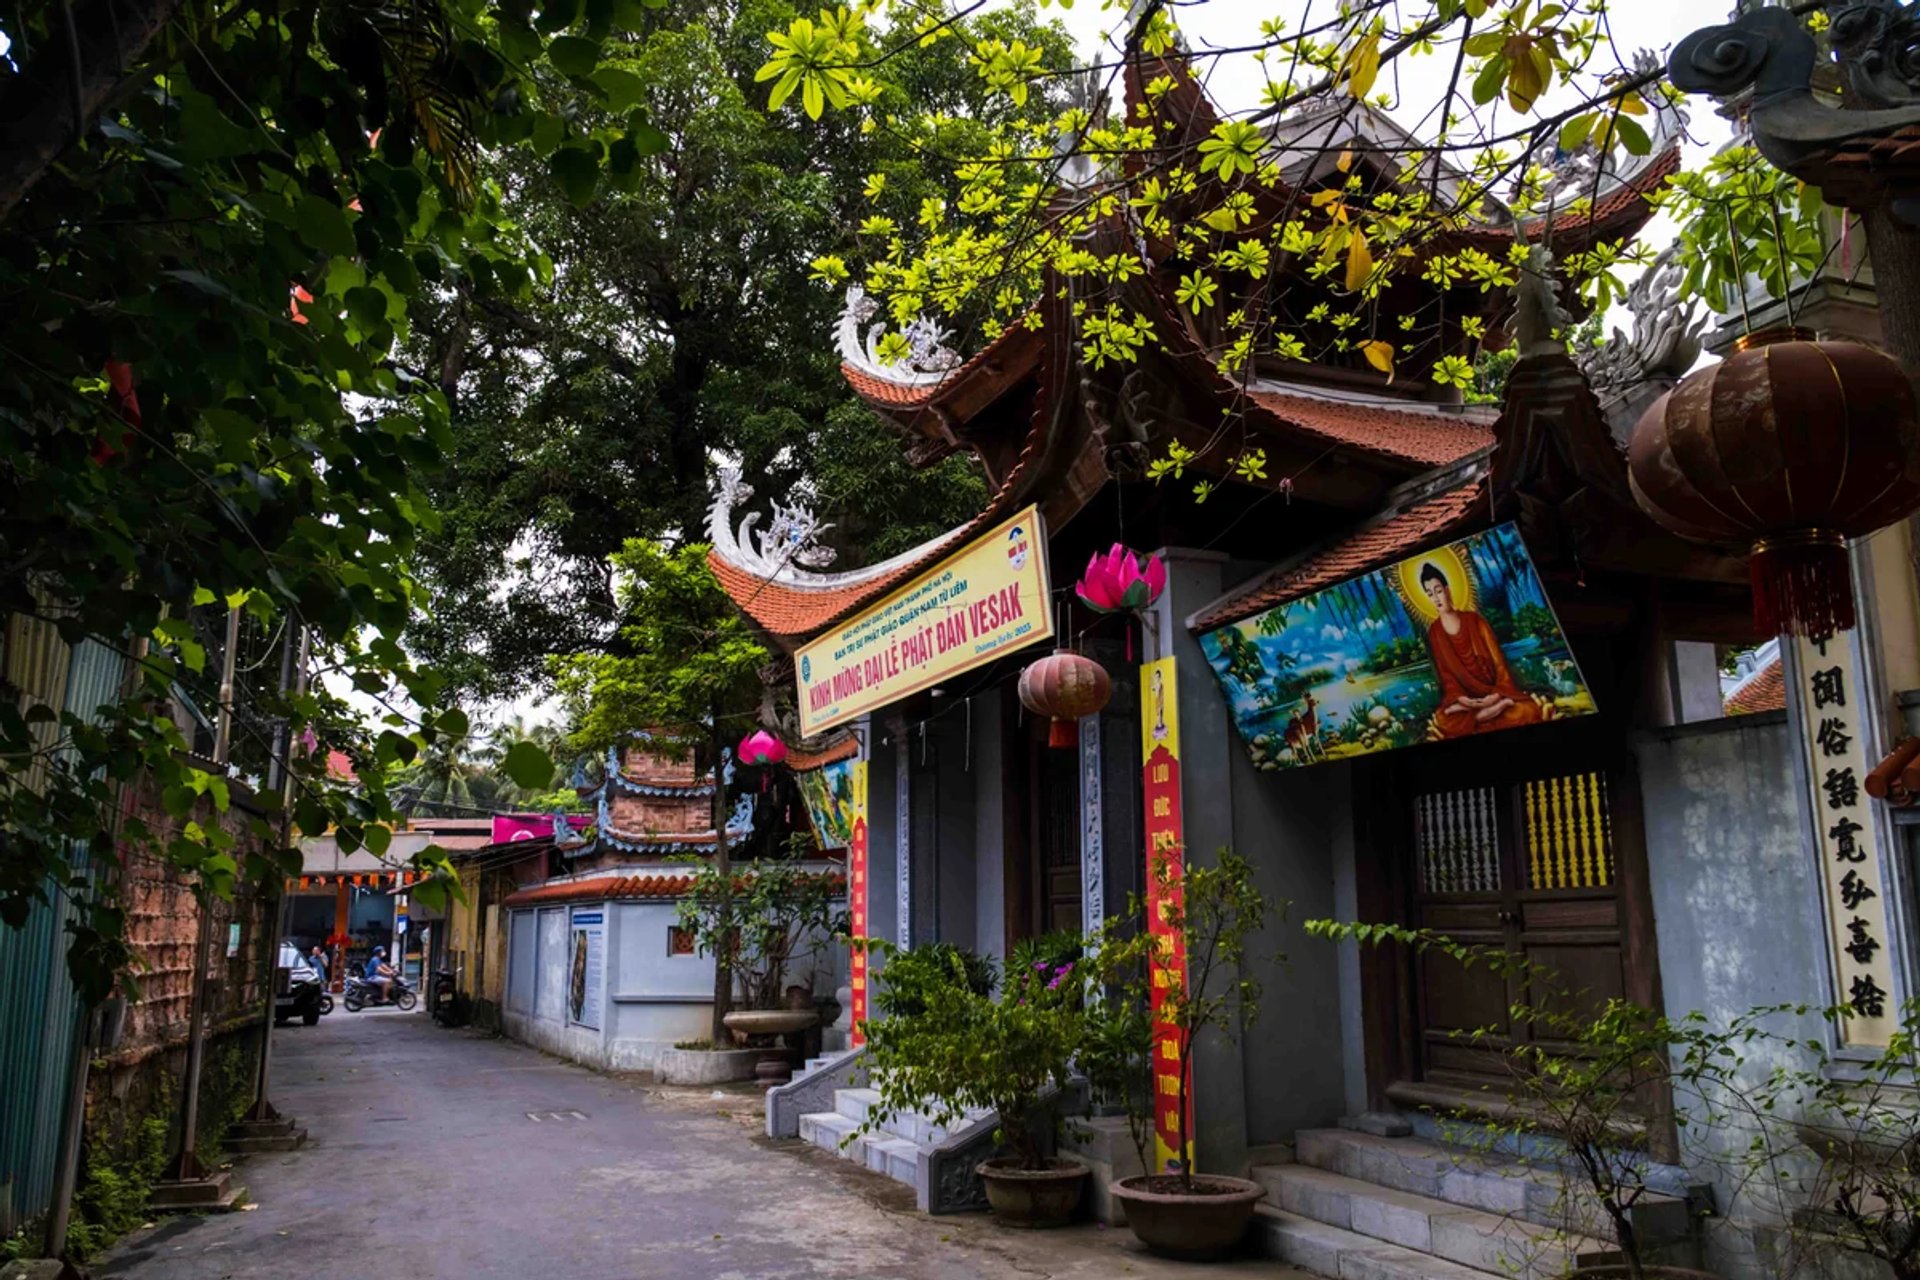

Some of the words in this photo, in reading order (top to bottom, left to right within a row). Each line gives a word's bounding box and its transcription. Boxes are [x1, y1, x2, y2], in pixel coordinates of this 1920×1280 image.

[899, 607, 919, 625] QUẬN
[920, 597, 938, 613] NAM
[939, 588, 949, 604] TỪ
[951, 579, 967, 598] LIÊM
[809, 679, 831, 713] KÍNH
[833, 663, 863, 702] MỪNG
[864, 653, 884, 691] ĐẠI
[885, 634, 899, 679] LỄ
[901, 623, 933, 671] PHẬT
[969, 581, 1023, 638] VESAK
